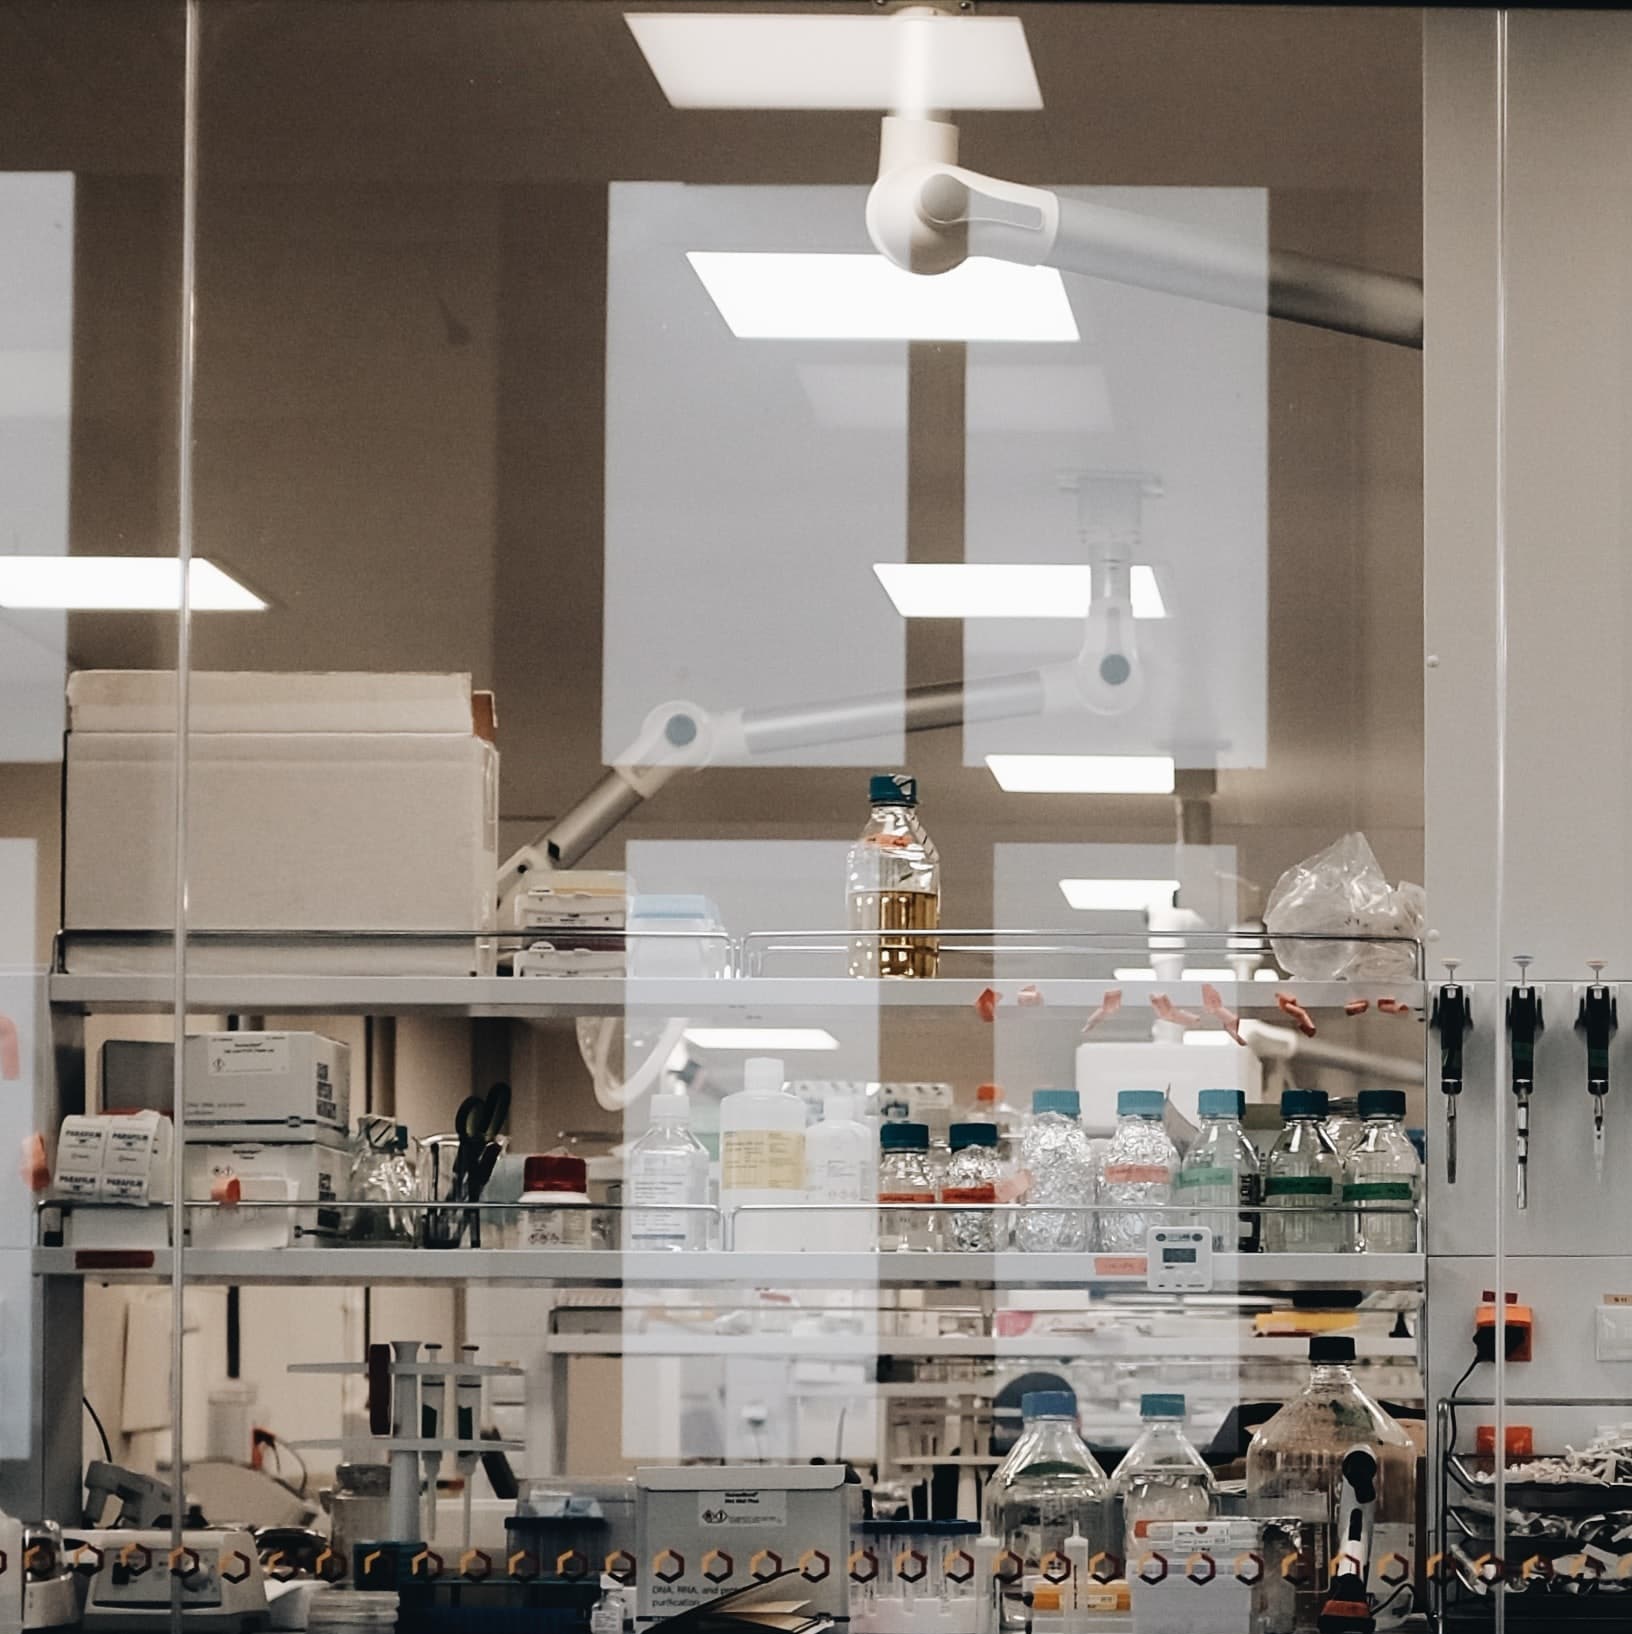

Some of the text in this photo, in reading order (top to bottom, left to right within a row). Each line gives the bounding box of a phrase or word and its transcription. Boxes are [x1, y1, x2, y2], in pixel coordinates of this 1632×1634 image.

[65, 1130, 102, 1138] PARAFILM
[112, 1132, 149, 1140] PARAFILM
[59, 1175, 96, 1184] PARAFILM
[106, 1178, 143, 1187] PARAFILM
[652, 1585, 675, 1595] DNA,
[677, 1585, 699, 1595] RNA,
[702, 1585, 719, 1594] and
